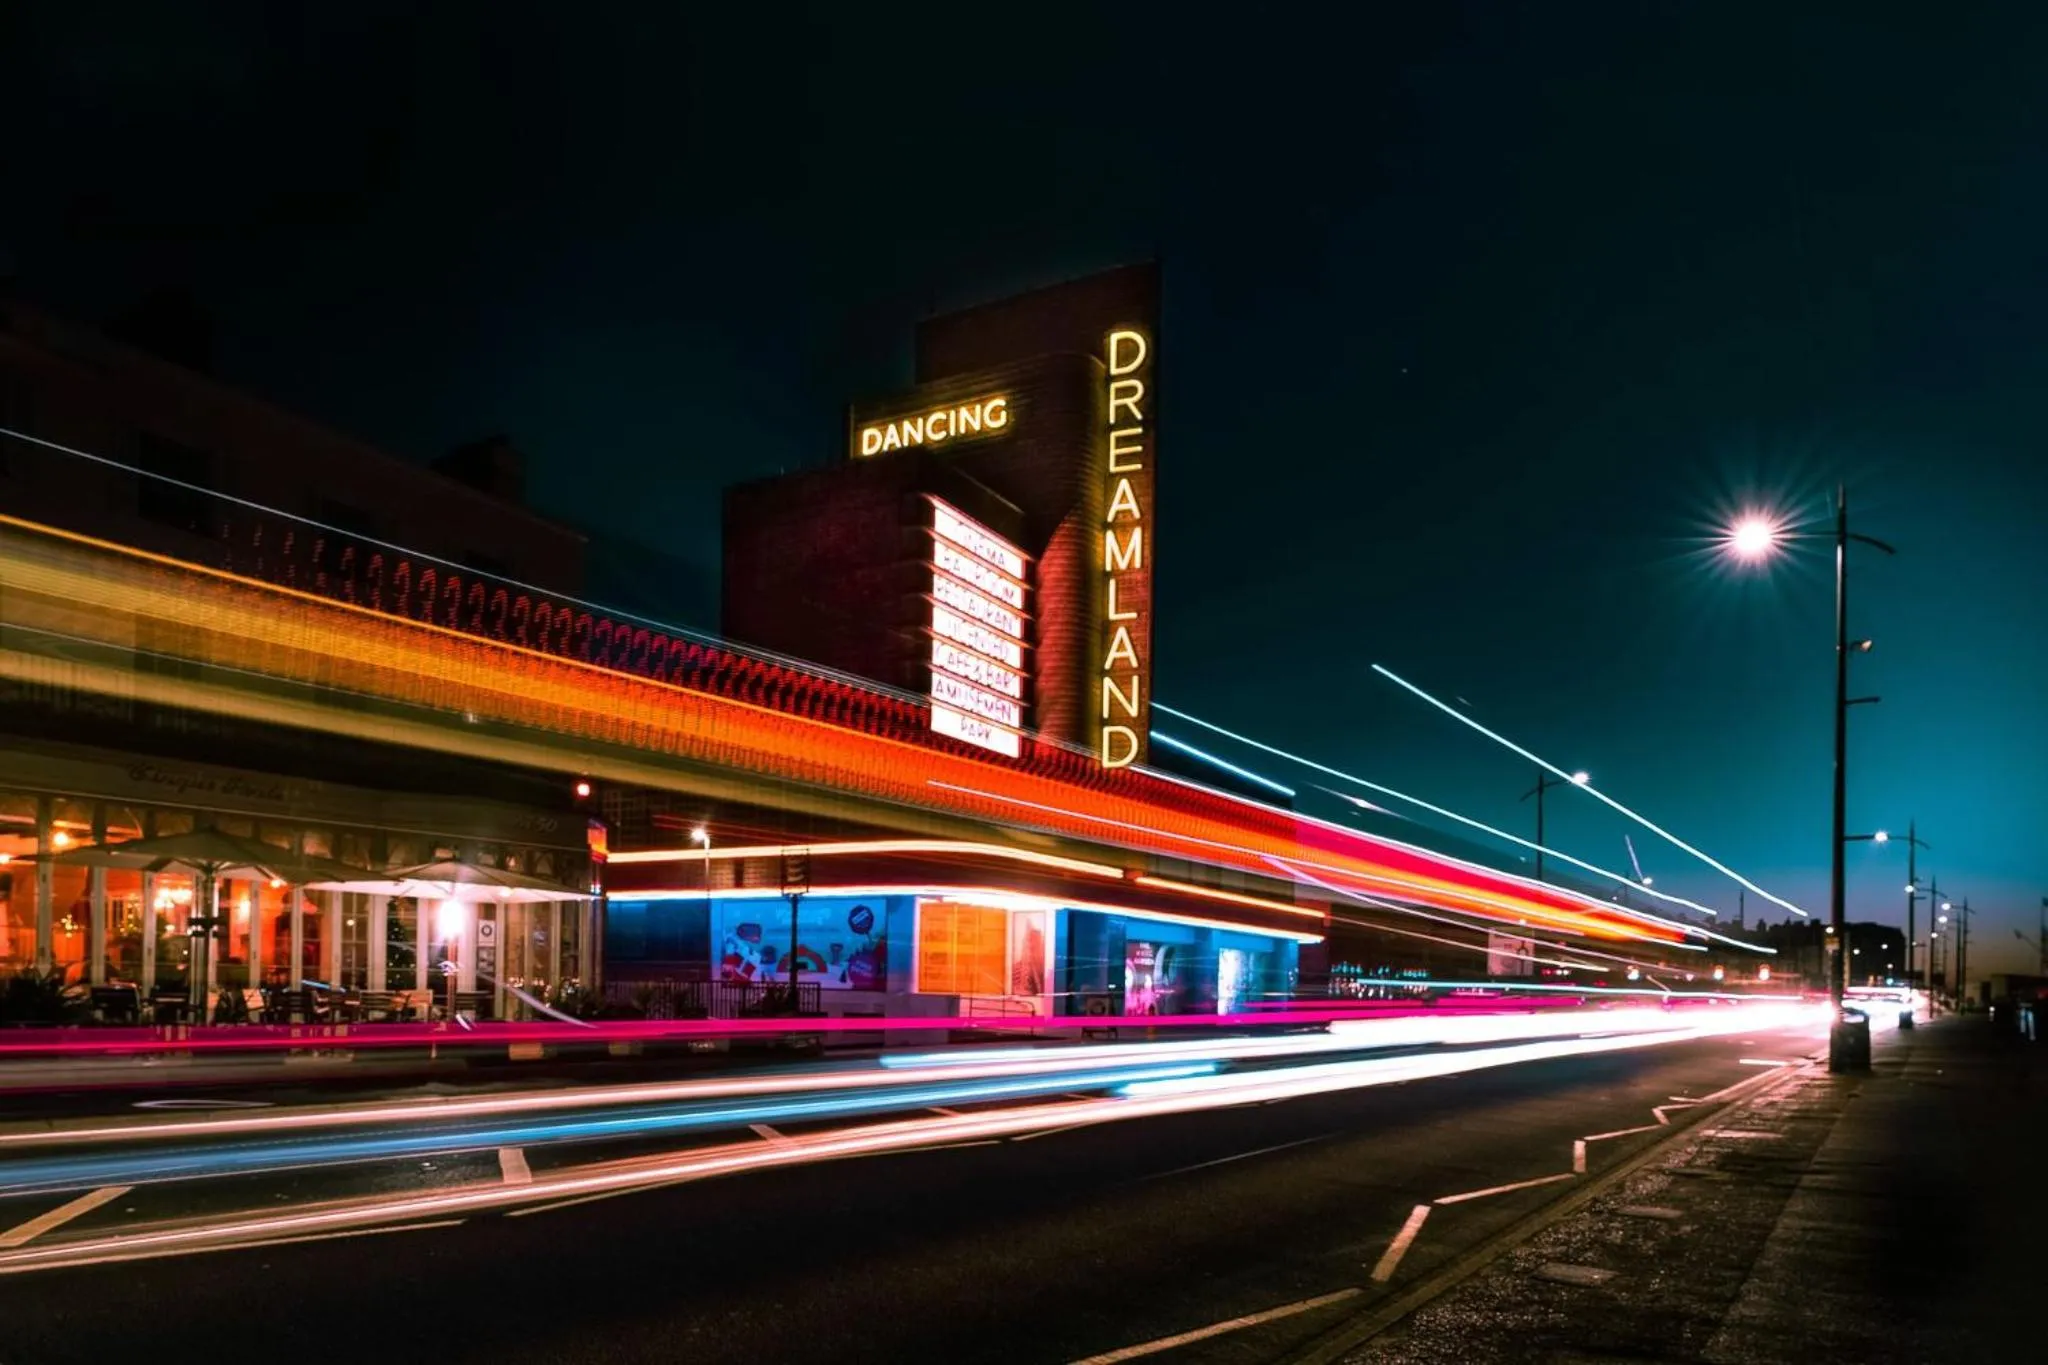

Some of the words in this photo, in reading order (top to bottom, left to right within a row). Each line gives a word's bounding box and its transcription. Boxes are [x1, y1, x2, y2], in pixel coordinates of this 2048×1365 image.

[862, 398, 1007, 456] DANCING
[956, 522, 1005, 567] NEMA
[1102, 331, 1146, 768] DREAMLAND
[936, 679, 1018, 724] AMUSEMEN
